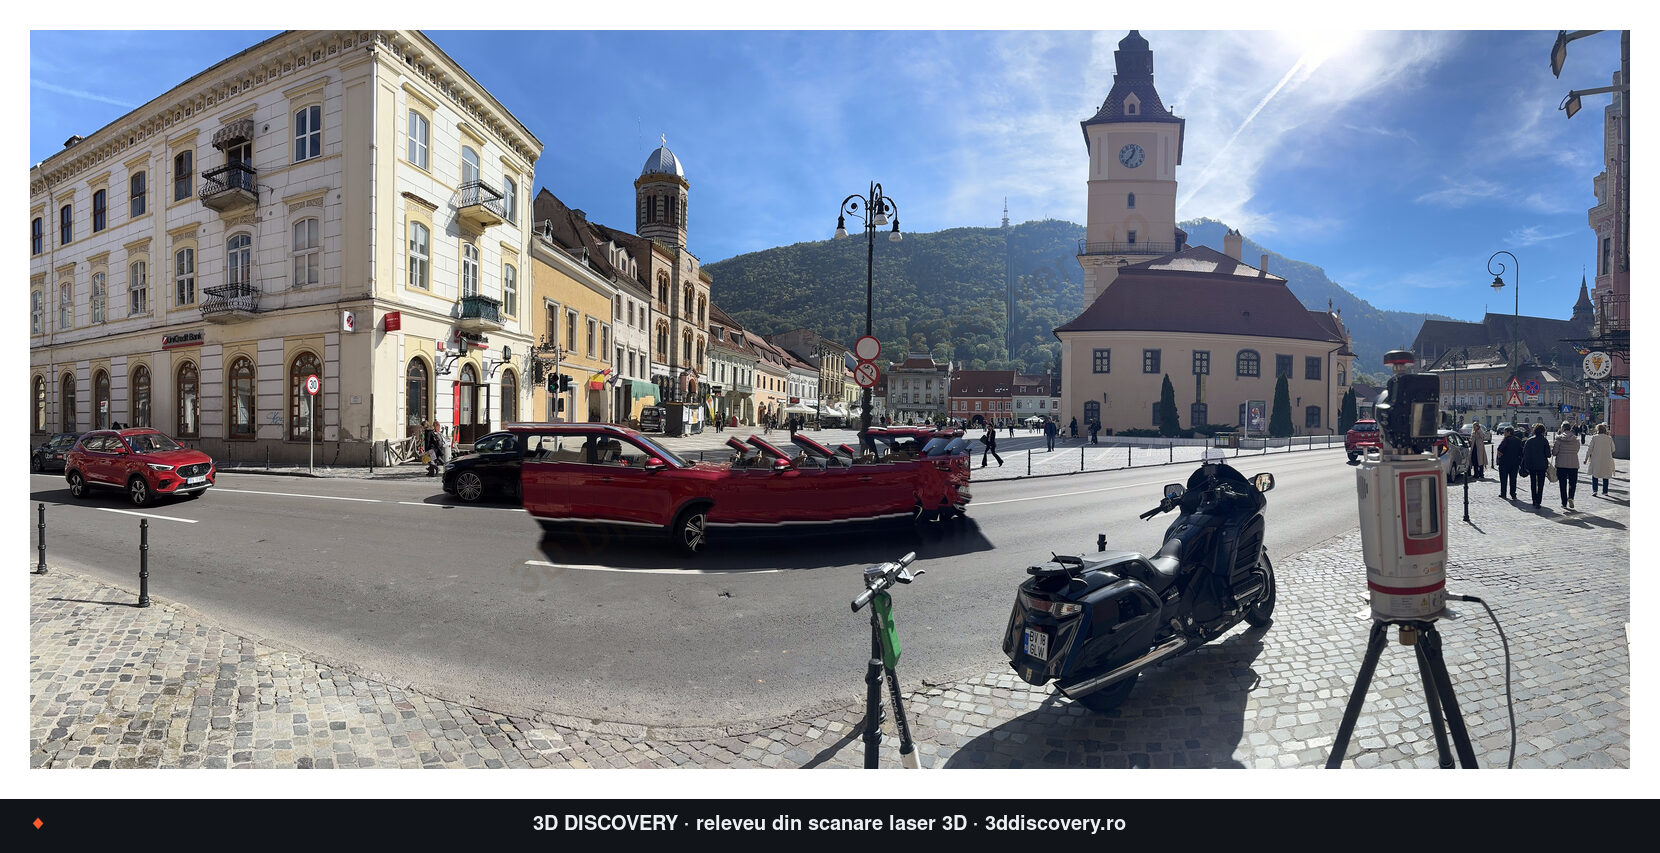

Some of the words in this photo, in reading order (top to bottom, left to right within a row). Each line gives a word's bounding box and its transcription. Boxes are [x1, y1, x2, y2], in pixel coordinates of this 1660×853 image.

[168, 333, 188, 343] UniCredit
[189, 332, 202, 341] Bank
[309, 379, 317, 390] 30
[1029, 630, 1039, 643] BV
[1040, 634, 1046, 646] 18
[1029, 643, 1045, 658] GLW
[886, 675, 893, 688] On
[890, 689, 899, 713] Lime
[897, 721, 905, 743] Uber
